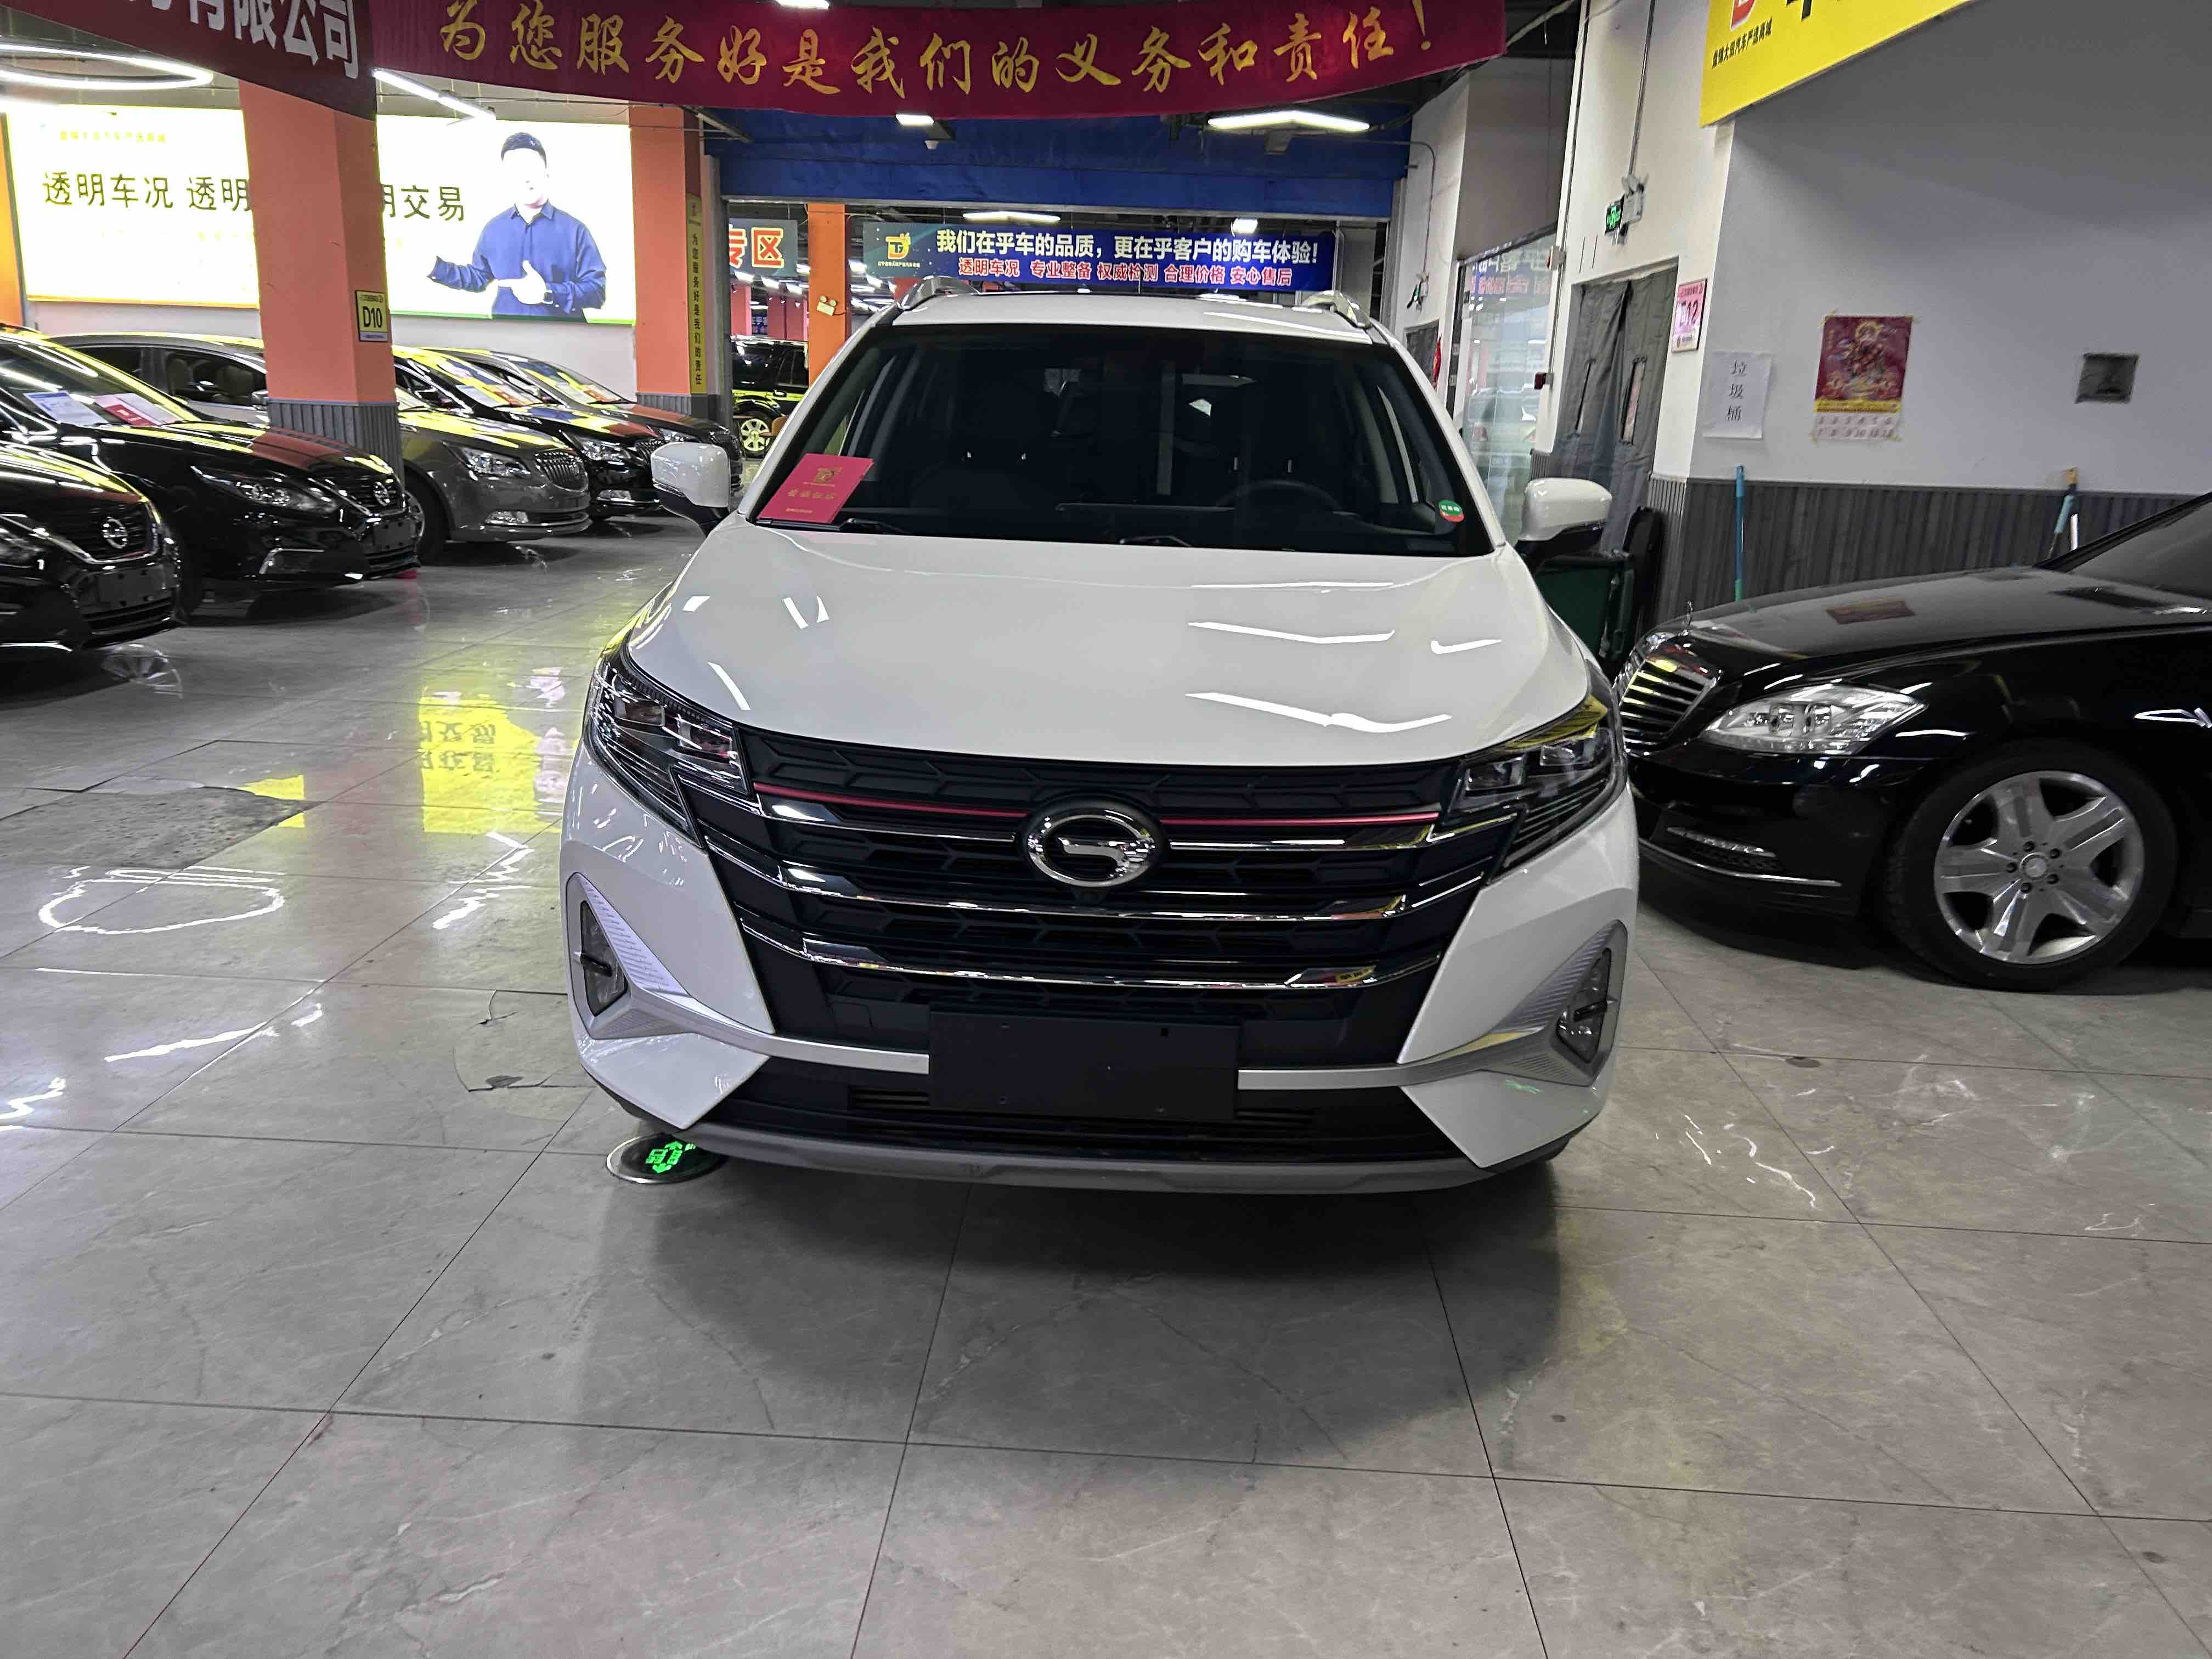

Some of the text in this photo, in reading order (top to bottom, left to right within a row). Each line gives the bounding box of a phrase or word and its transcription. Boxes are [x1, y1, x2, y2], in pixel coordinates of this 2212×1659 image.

[43, 171, 173, 208] 透明车况
[958, 257, 1293, 286] 透明车况 专业整备 权威检测 合理价格 安心售后
[363, 306, 382, 328] D10
[1725, 359, 1747, 421] 垃圾桶
